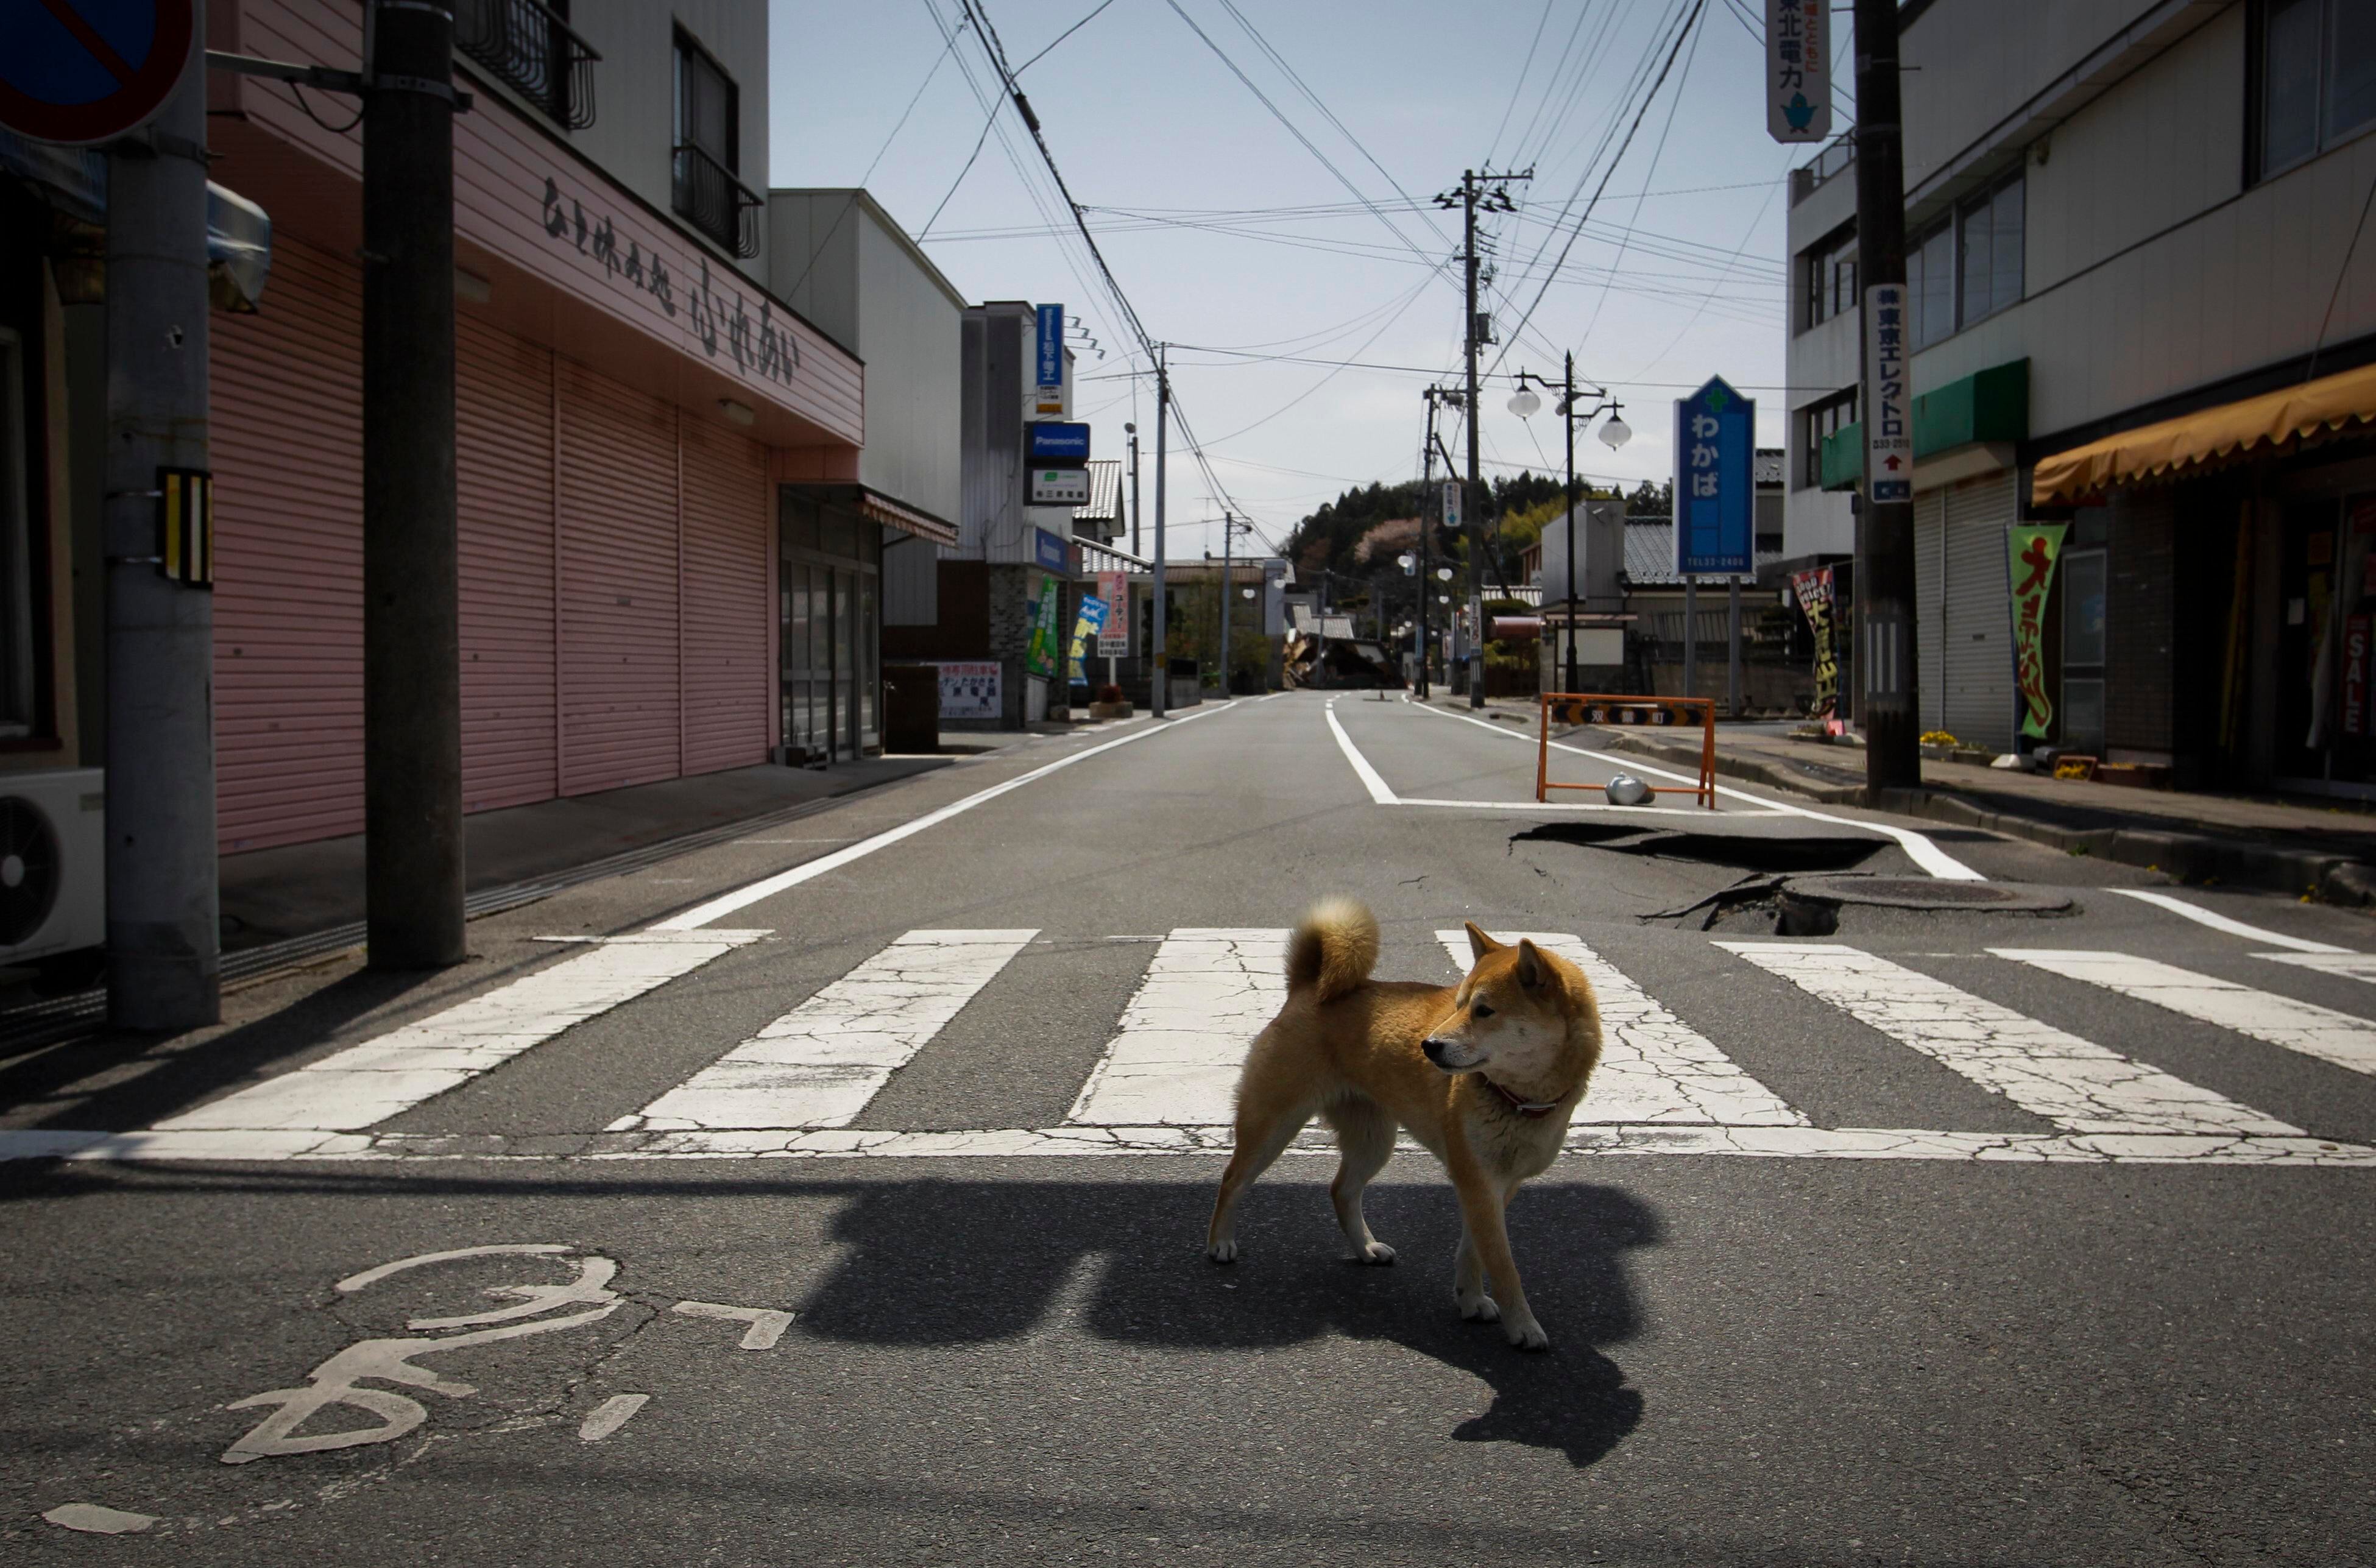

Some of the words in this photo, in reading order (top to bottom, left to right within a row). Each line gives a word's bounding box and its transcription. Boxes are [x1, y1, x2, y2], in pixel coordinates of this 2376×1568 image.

[691, 256, 800, 387] ふれあい
[1036, 436, 1084, 445] Panasonic
[1691, 414, 1719, 498] わかば
[2344, 632, 2365, 733] SALE
